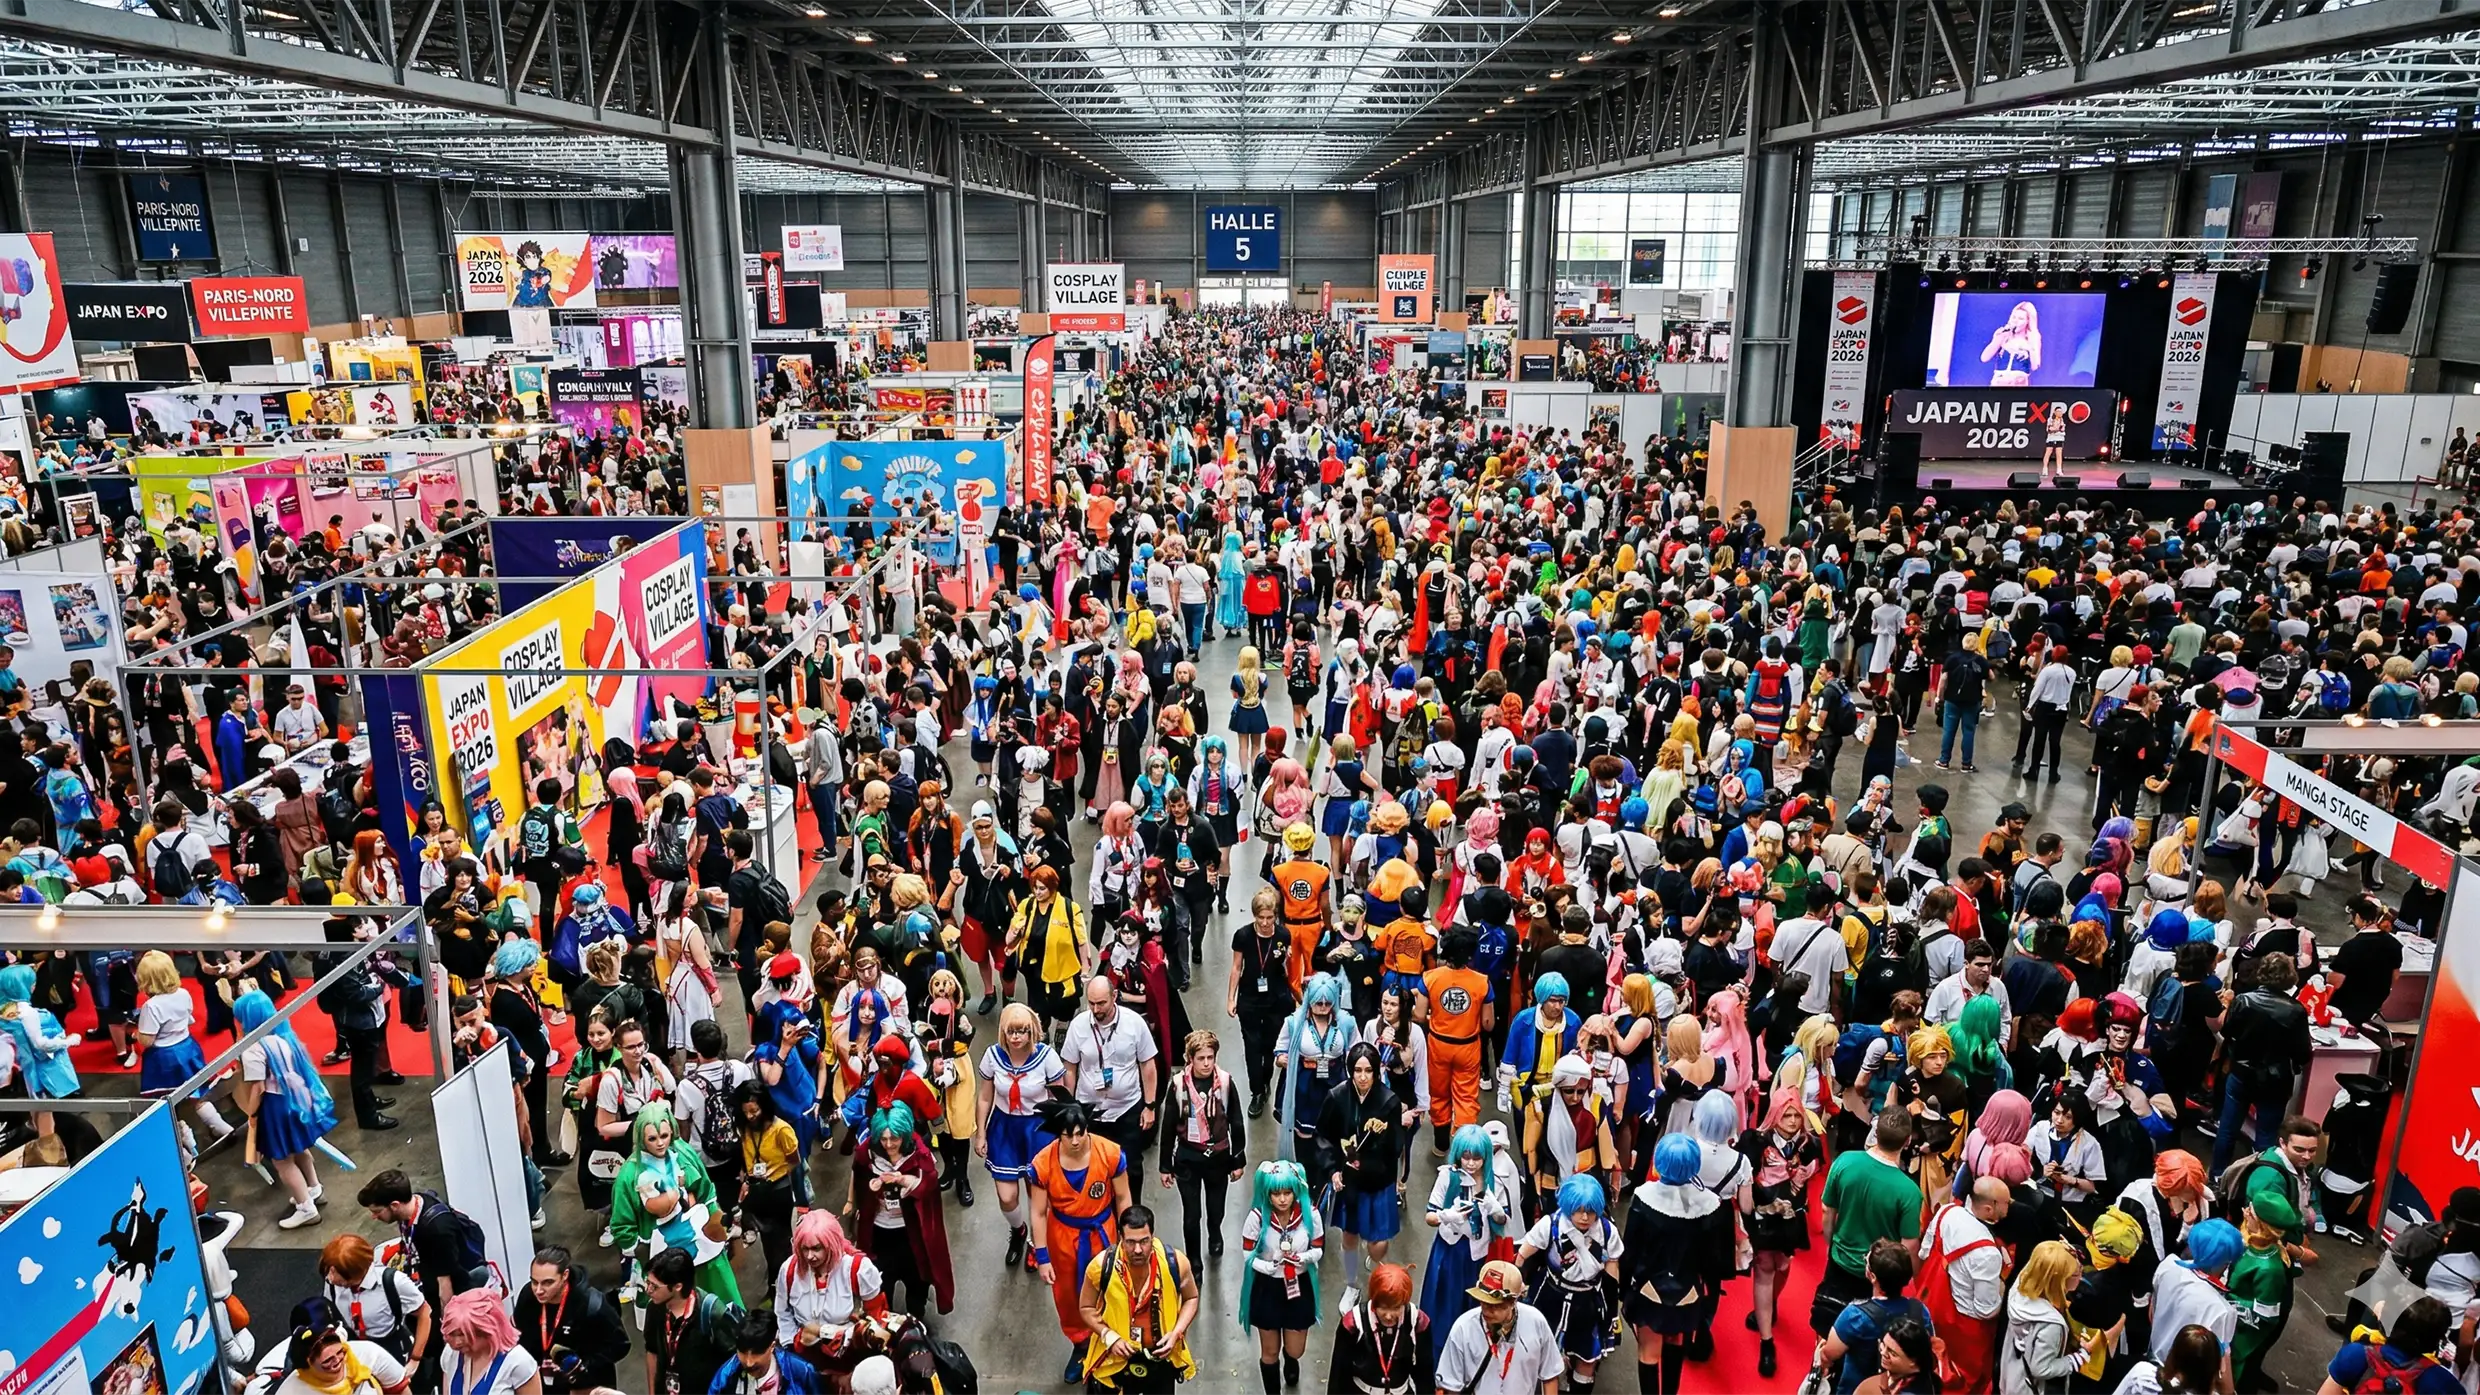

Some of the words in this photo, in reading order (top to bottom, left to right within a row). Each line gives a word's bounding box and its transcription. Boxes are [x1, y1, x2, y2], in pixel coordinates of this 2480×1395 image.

[136, 202, 200, 217] PARIS-NORD
[139, 218, 202, 232] VILLEPINTE
[1211, 213, 1275, 230] HALLE
[466, 250, 502, 261] JAPAN
[1235, 237, 1251, 261] 5
[467, 261, 503, 271] EXPO
[469, 271, 504, 284] 2026
[1053, 274, 1118, 287] COSPLAY
[203, 288, 294, 304] PARIS-NORD
[1055, 290, 1118, 304] VILLAGE
[77, 304, 122, 318] JAPAN
[125, 305, 168, 320] EXPO
[207, 305, 293, 322] VILLEPINTE
[1831, 350, 1864, 362] 2026
[2167, 351, 2201, 362] 2026
[1906, 401, 2001, 424] JAPAN
[1966, 427, 2030, 449] 2026
[645, 562, 691, 612] COSPLAY
[649, 593, 695, 641] VILLAGE
[504, 628, 558, 679] COSPLAY
[508, 656, 563, 710] VILLAGE
[448, 682, 486, 721] JAPAN
[451, 708, 490, 750] EXPO
[2285, 771, 2327, 809] MANGA
[2329, 797, 2370, 832] STAGE
